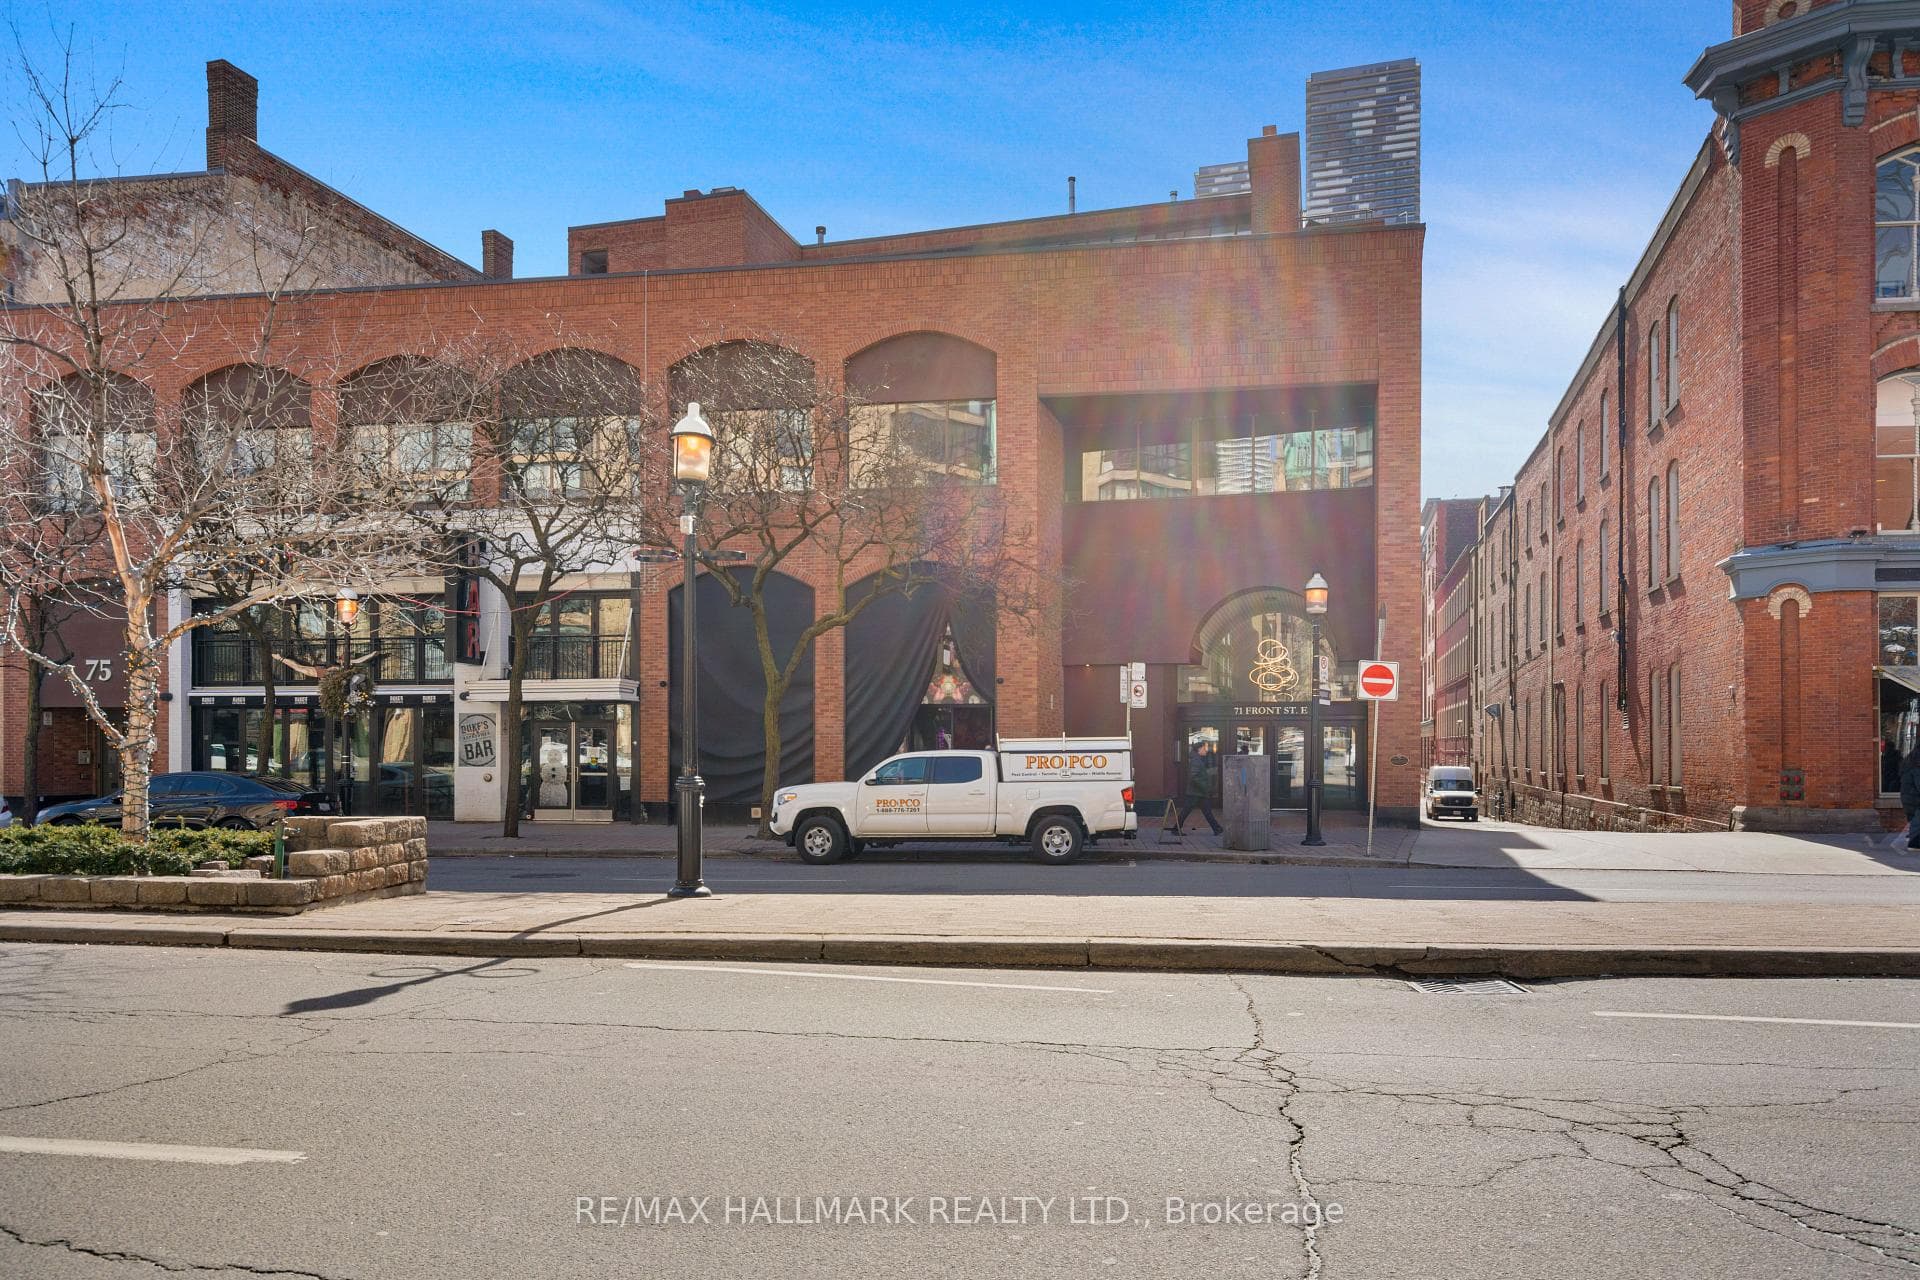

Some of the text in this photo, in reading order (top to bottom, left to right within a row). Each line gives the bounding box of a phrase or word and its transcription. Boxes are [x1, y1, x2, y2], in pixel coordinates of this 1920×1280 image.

[85, 659, 112, 681] 75
[1234, 706, 1308, 715] 71 FRONT ST. E
[460, 720, 489, 734] DUKE'S
[464, 739, 494, 760] BAR
